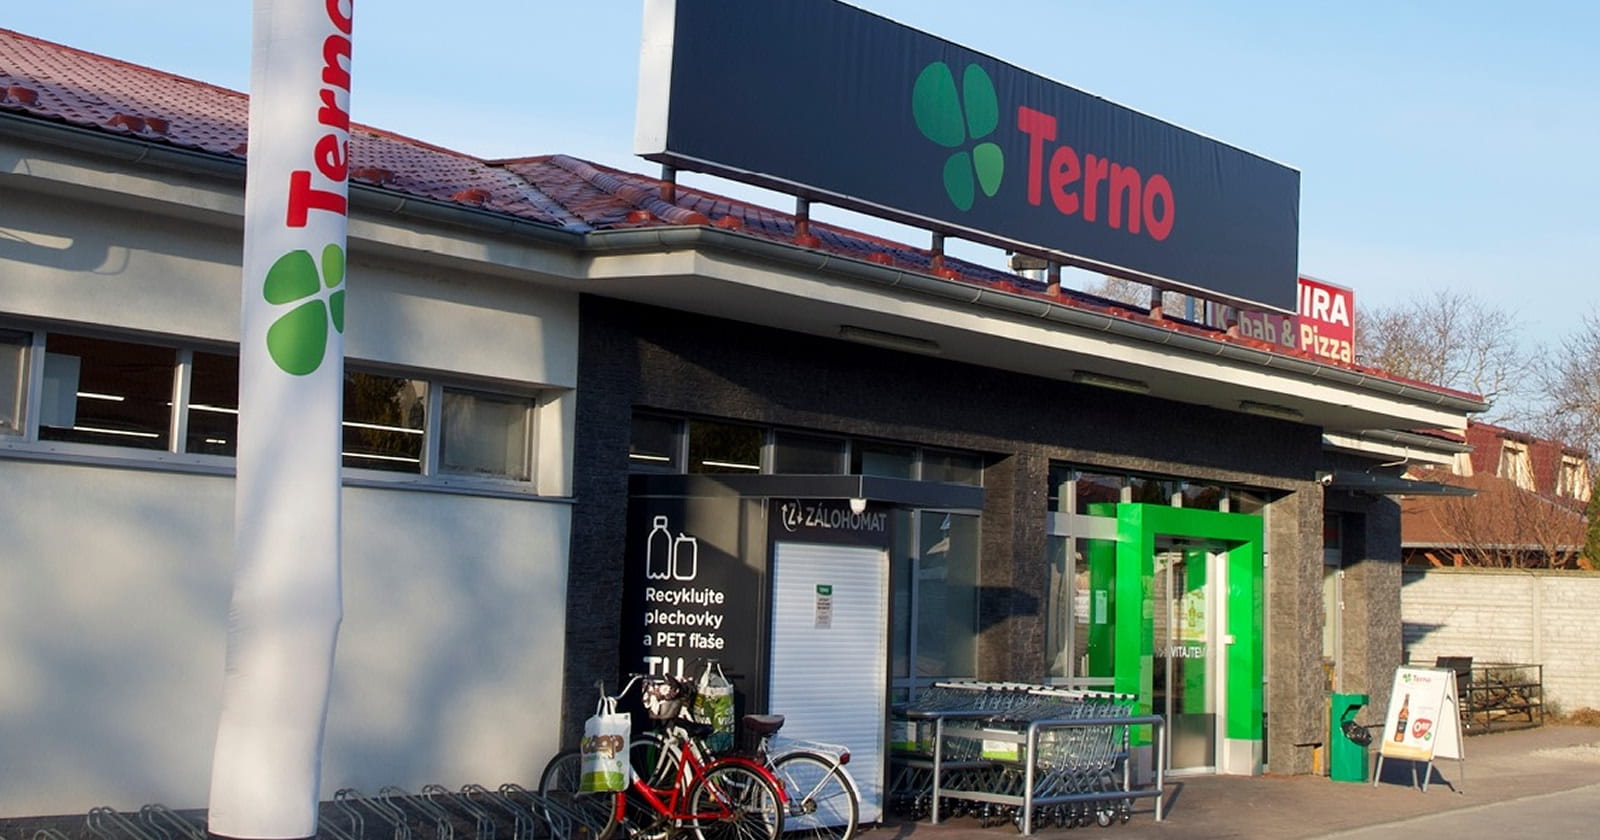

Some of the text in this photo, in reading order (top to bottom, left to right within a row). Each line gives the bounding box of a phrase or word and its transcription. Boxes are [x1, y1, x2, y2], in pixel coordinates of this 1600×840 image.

[1017, 105, 1175, 241] Terno
[1297, 283, 1350, 327] IRA
[1215, 303, 1352, 364] Kbab & Pizza
[805, 502, 887, 532] ZÁLOHOMAT
[645, 587, 725, 606] Recyklujte
[644, 609, 723, 629] plechovky
[643, 632, 724, 649] a PET fľaše
